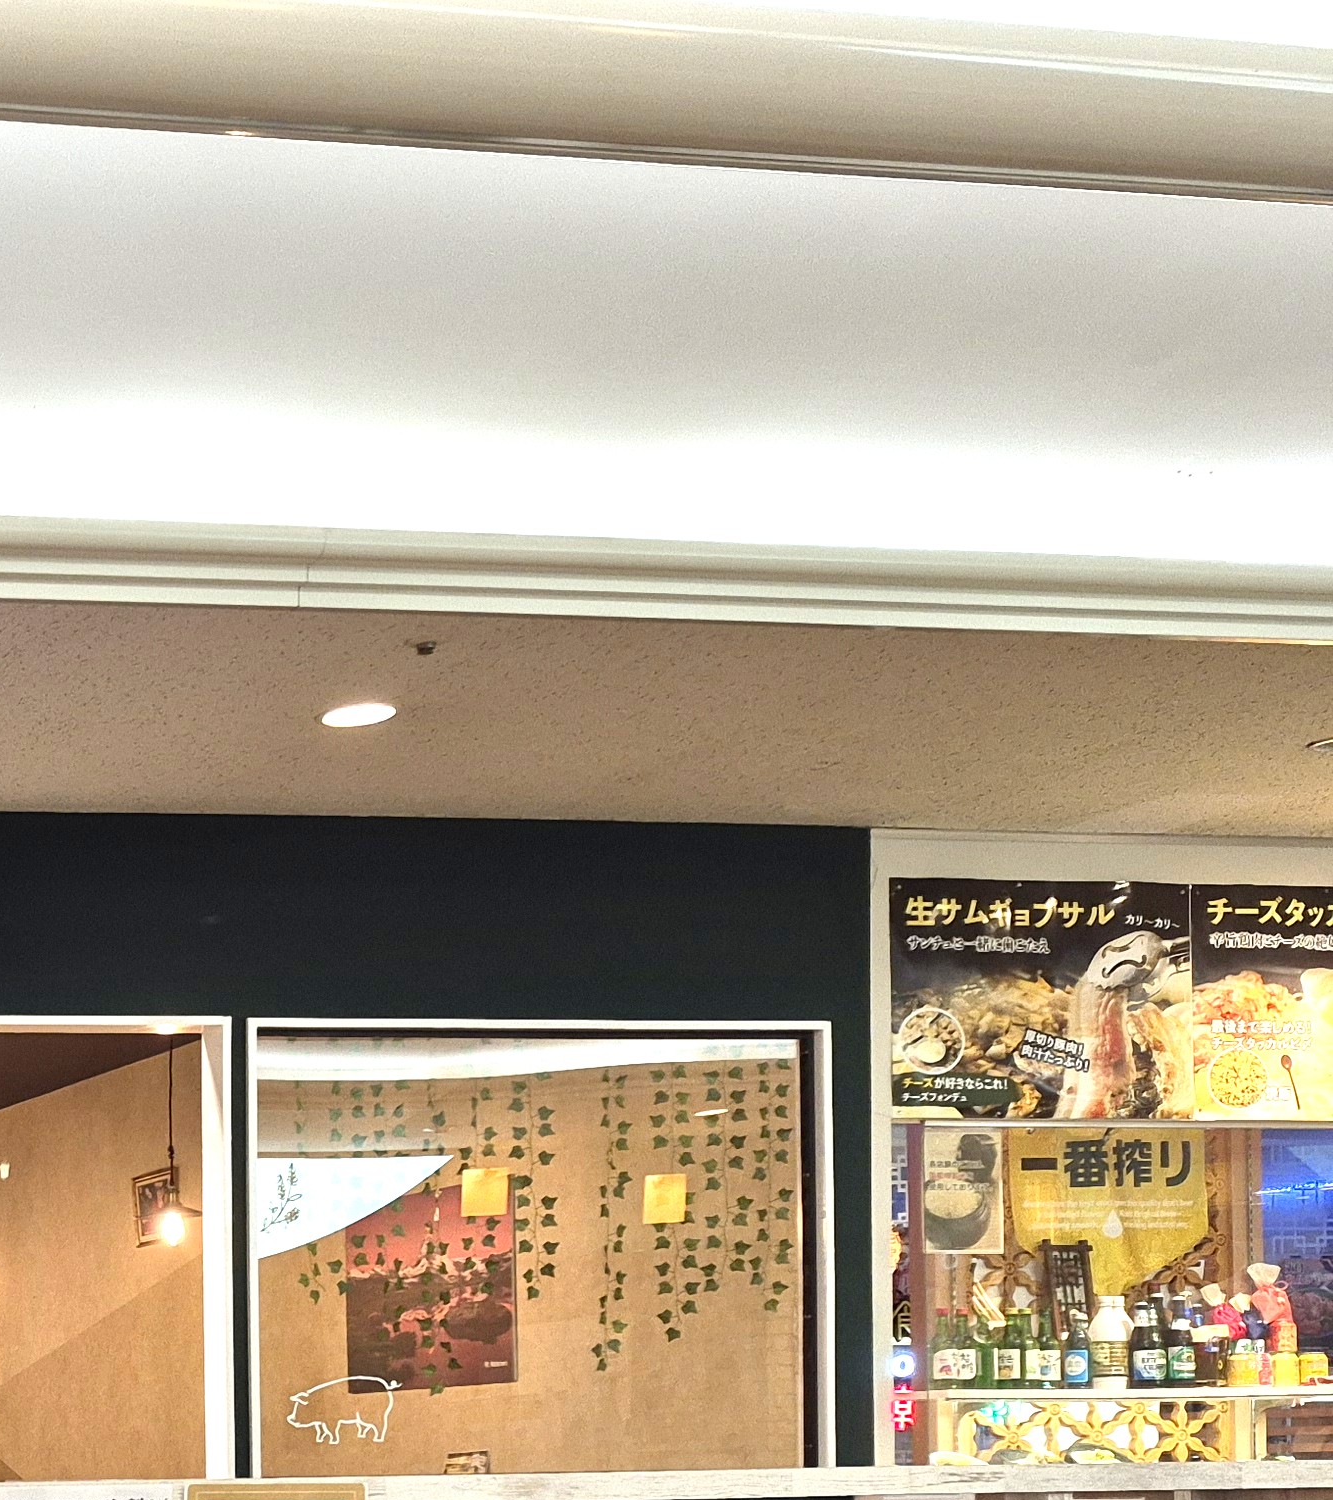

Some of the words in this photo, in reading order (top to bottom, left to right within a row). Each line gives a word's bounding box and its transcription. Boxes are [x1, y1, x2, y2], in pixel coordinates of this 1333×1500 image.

[905, 895, 1115, 928] 生サムギョプサル
[902, 1077, 1008, 1091] チーズが好きならこれ!
[1021, 1139, 1191, 1188] 一番搾り
